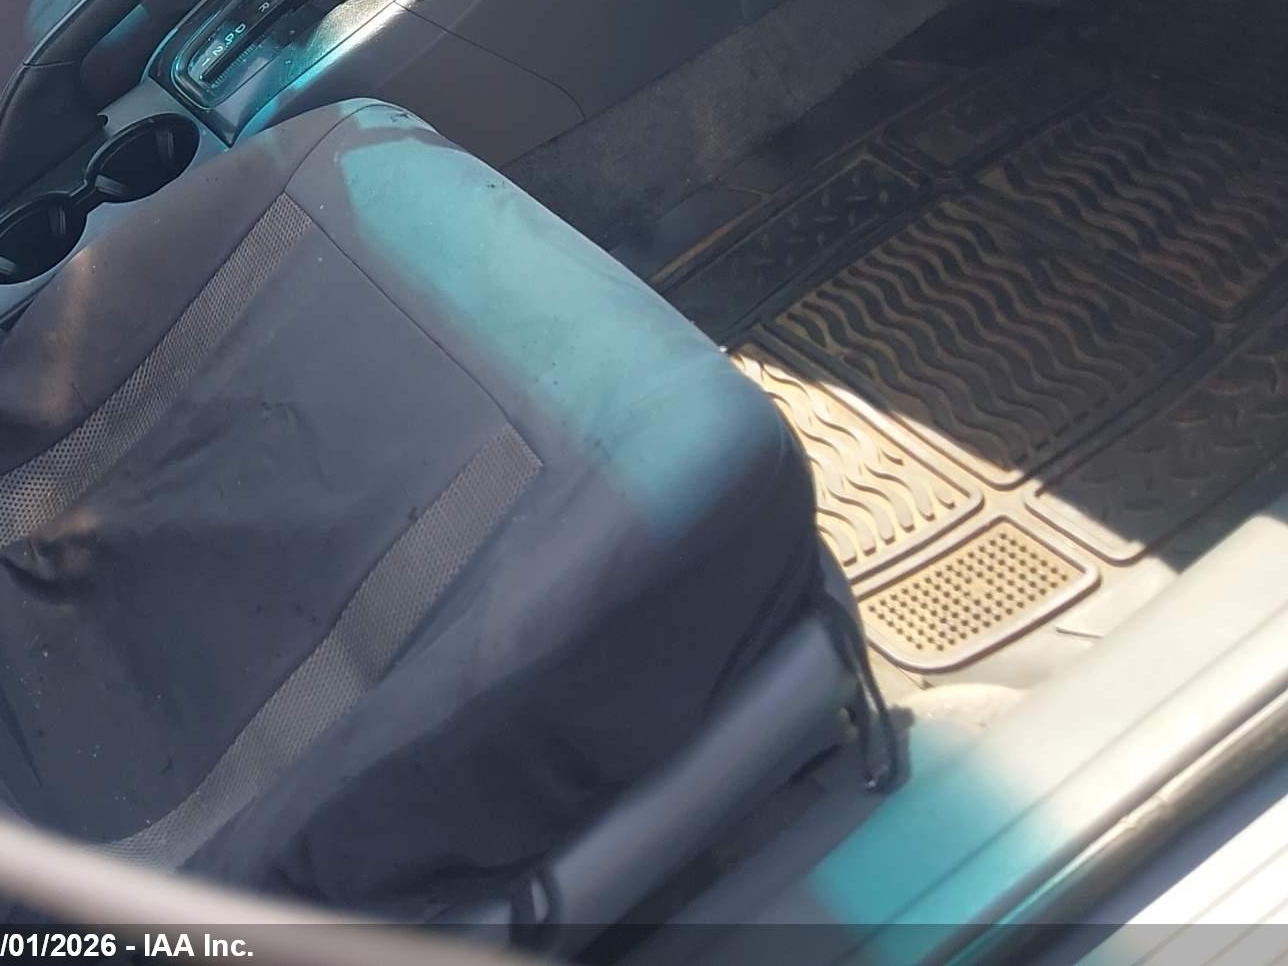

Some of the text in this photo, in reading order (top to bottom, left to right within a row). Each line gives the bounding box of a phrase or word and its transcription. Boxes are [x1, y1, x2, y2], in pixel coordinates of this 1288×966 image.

[258, 1, 270, 12] R
[235, 23, 246, 33] D
[212, 45, 223, 56] 2
